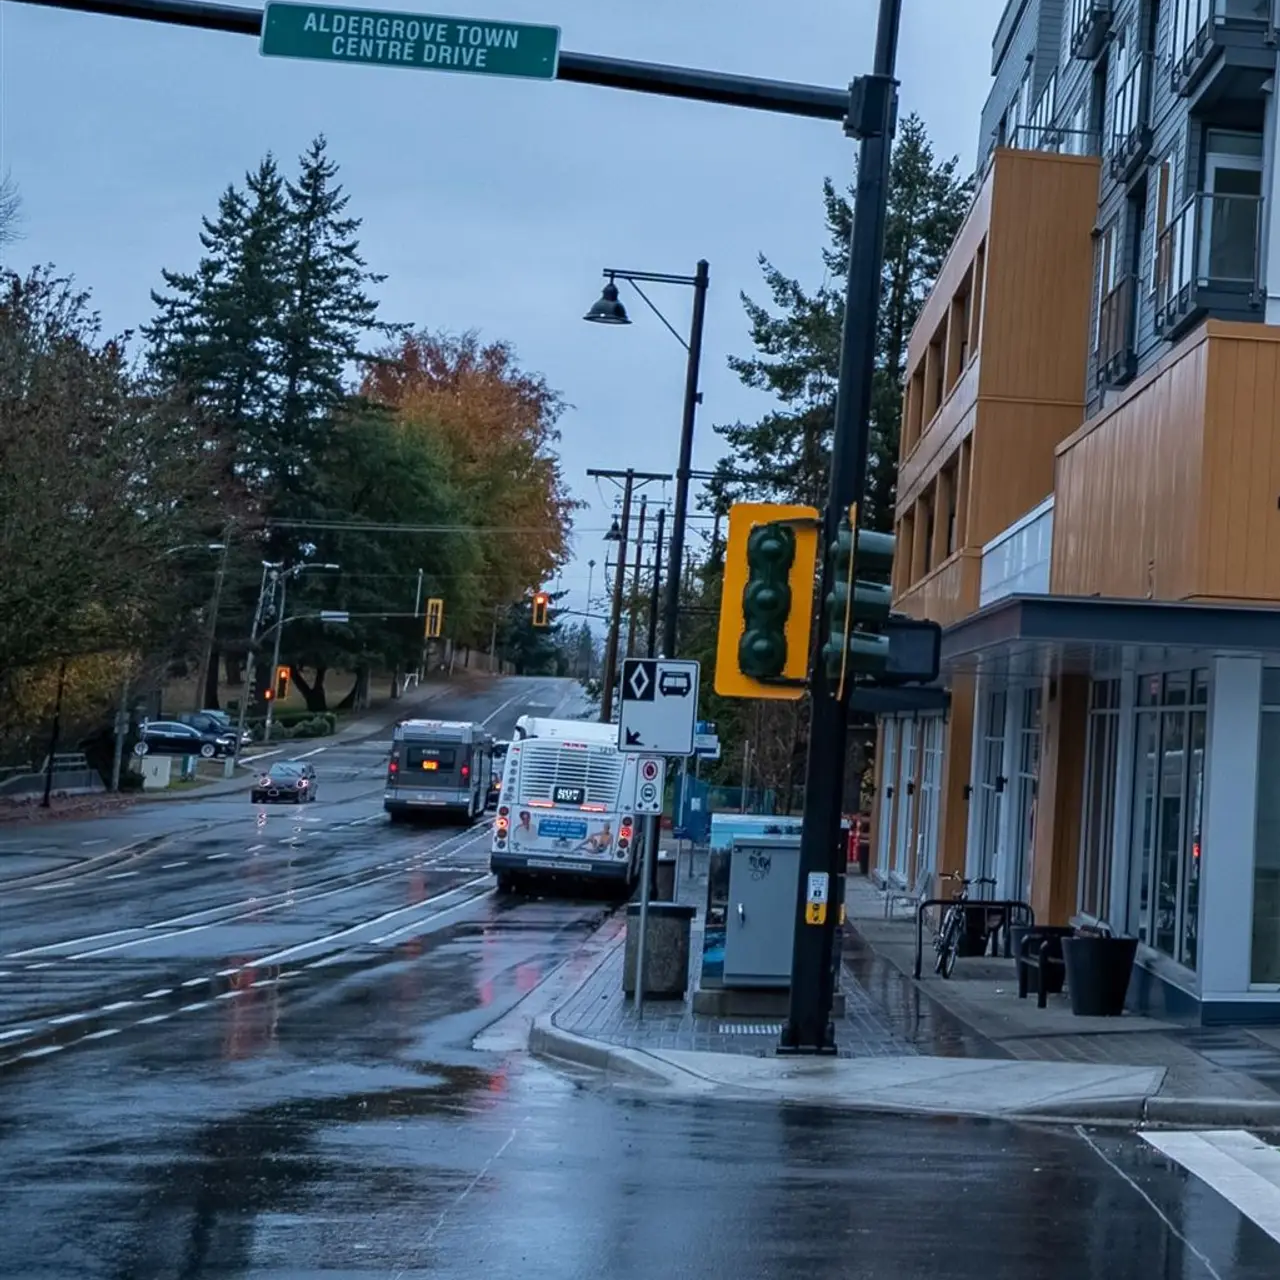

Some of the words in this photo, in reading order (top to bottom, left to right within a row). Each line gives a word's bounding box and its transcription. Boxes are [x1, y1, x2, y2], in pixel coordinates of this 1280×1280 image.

[304, 12, 448, 44] ALDERGROVE
[456, 25, 520, 50] TOWN
[331, 36, 414, 61] CENTRE
[423, 45, 487, 68] DRIVE
